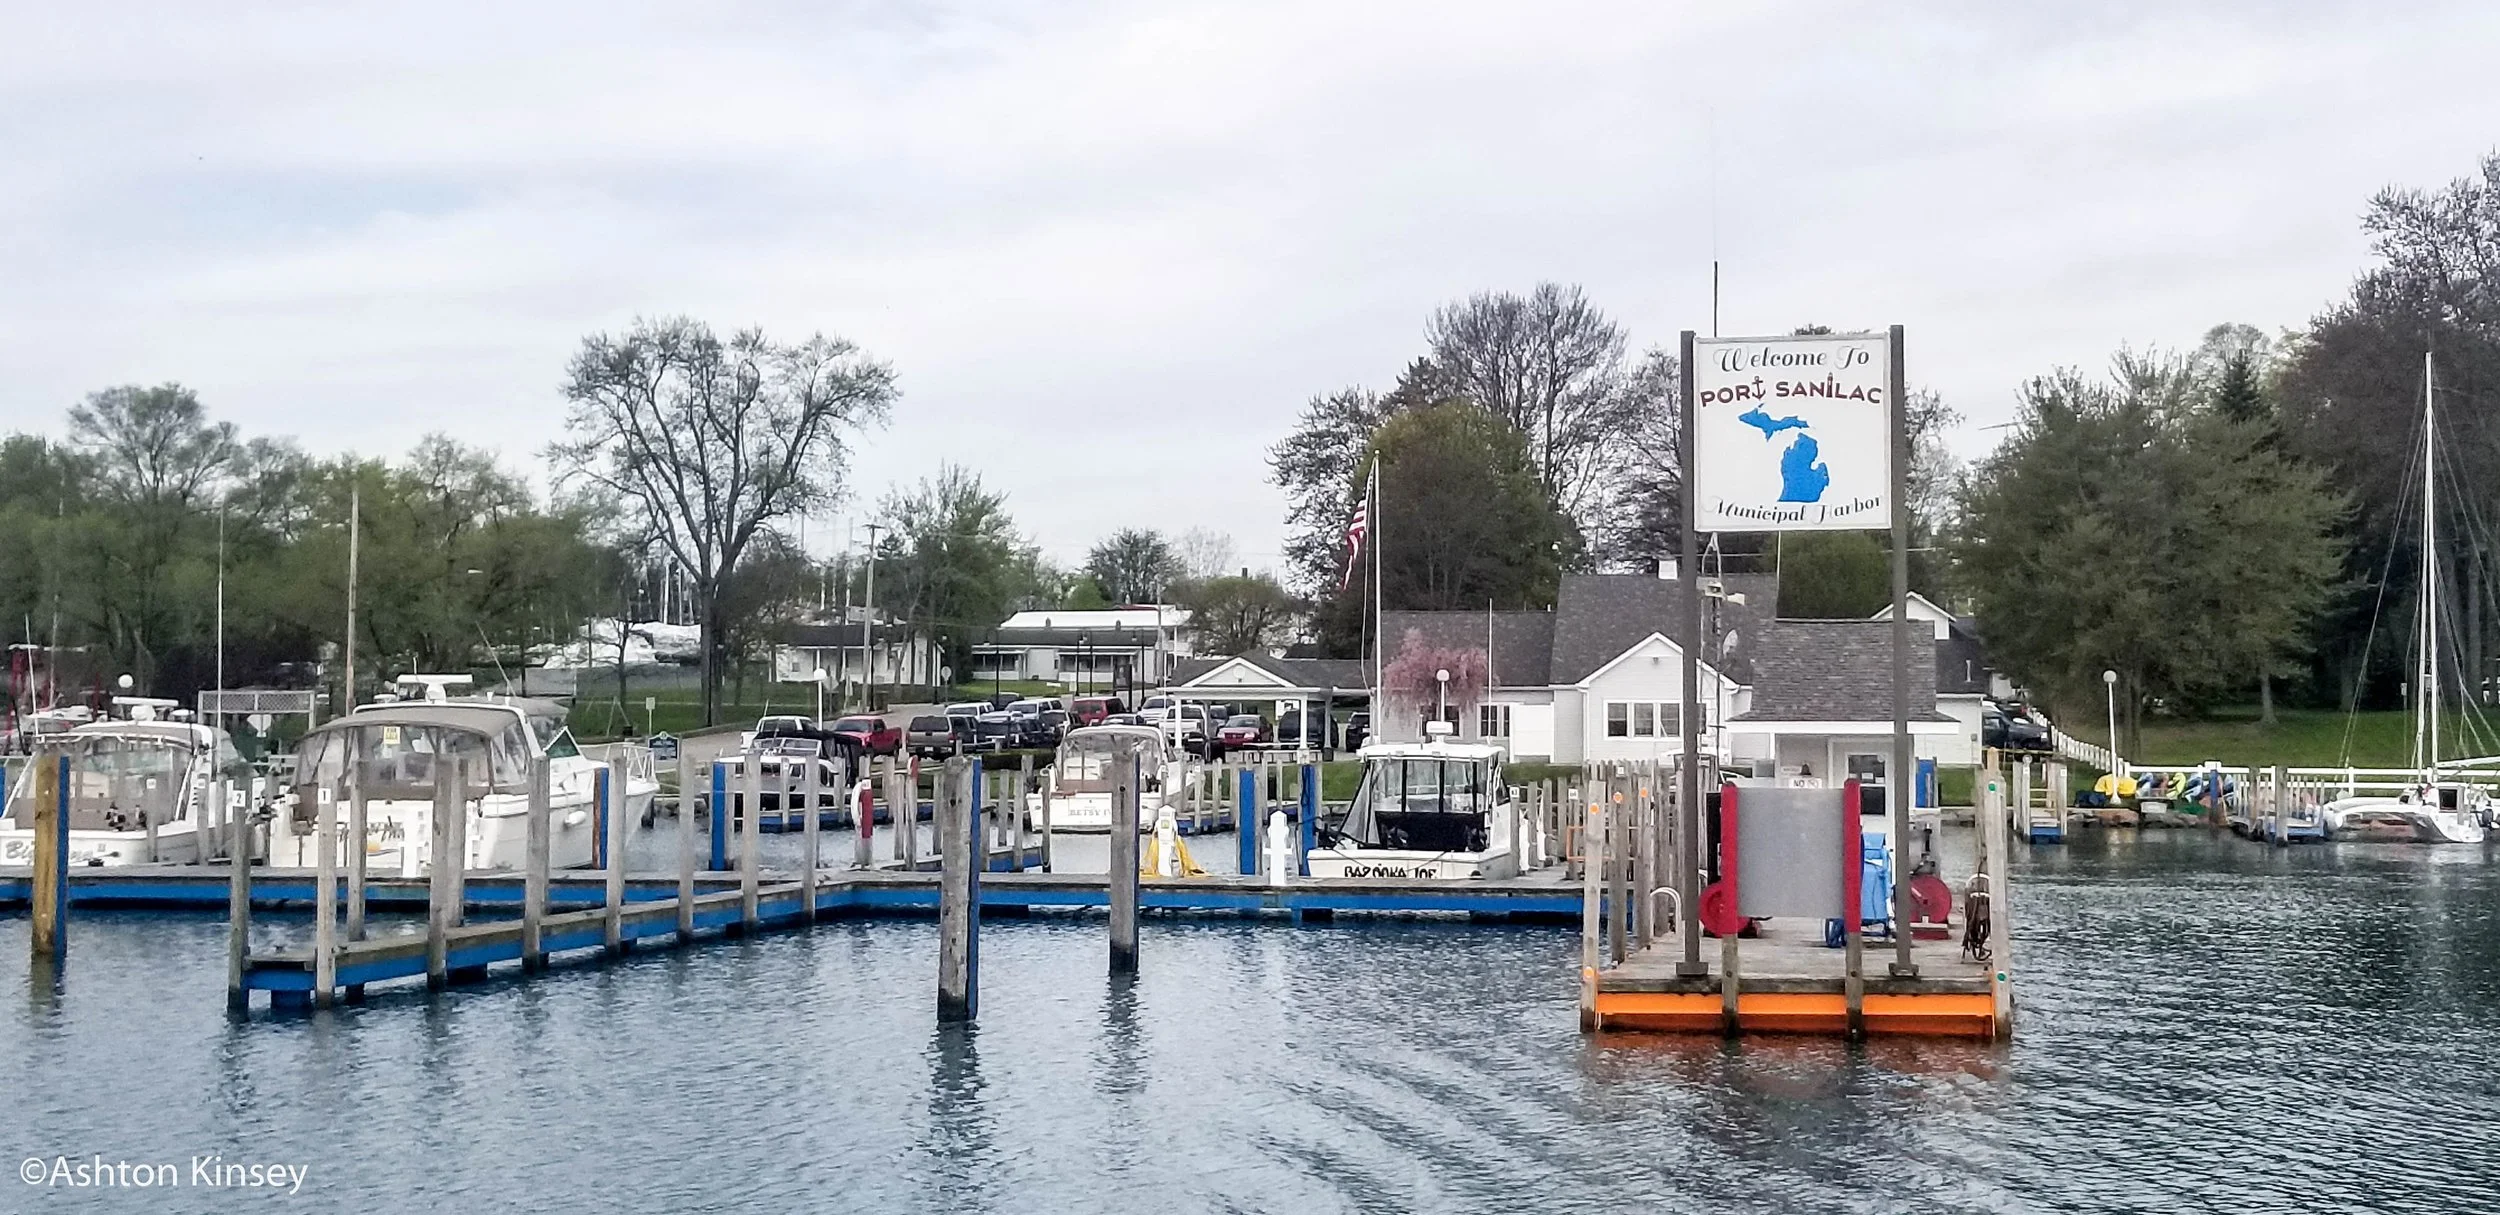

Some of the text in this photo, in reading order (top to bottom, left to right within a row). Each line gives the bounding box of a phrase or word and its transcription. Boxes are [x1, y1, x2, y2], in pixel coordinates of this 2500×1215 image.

[1713, 345, 1870, 372] Welcome To
[1700, 371, 1883, 407] PORT SANILAC
[1701, 494, 1884, 525] Municipal Harbor
[236, 792, 243, 804] 2
